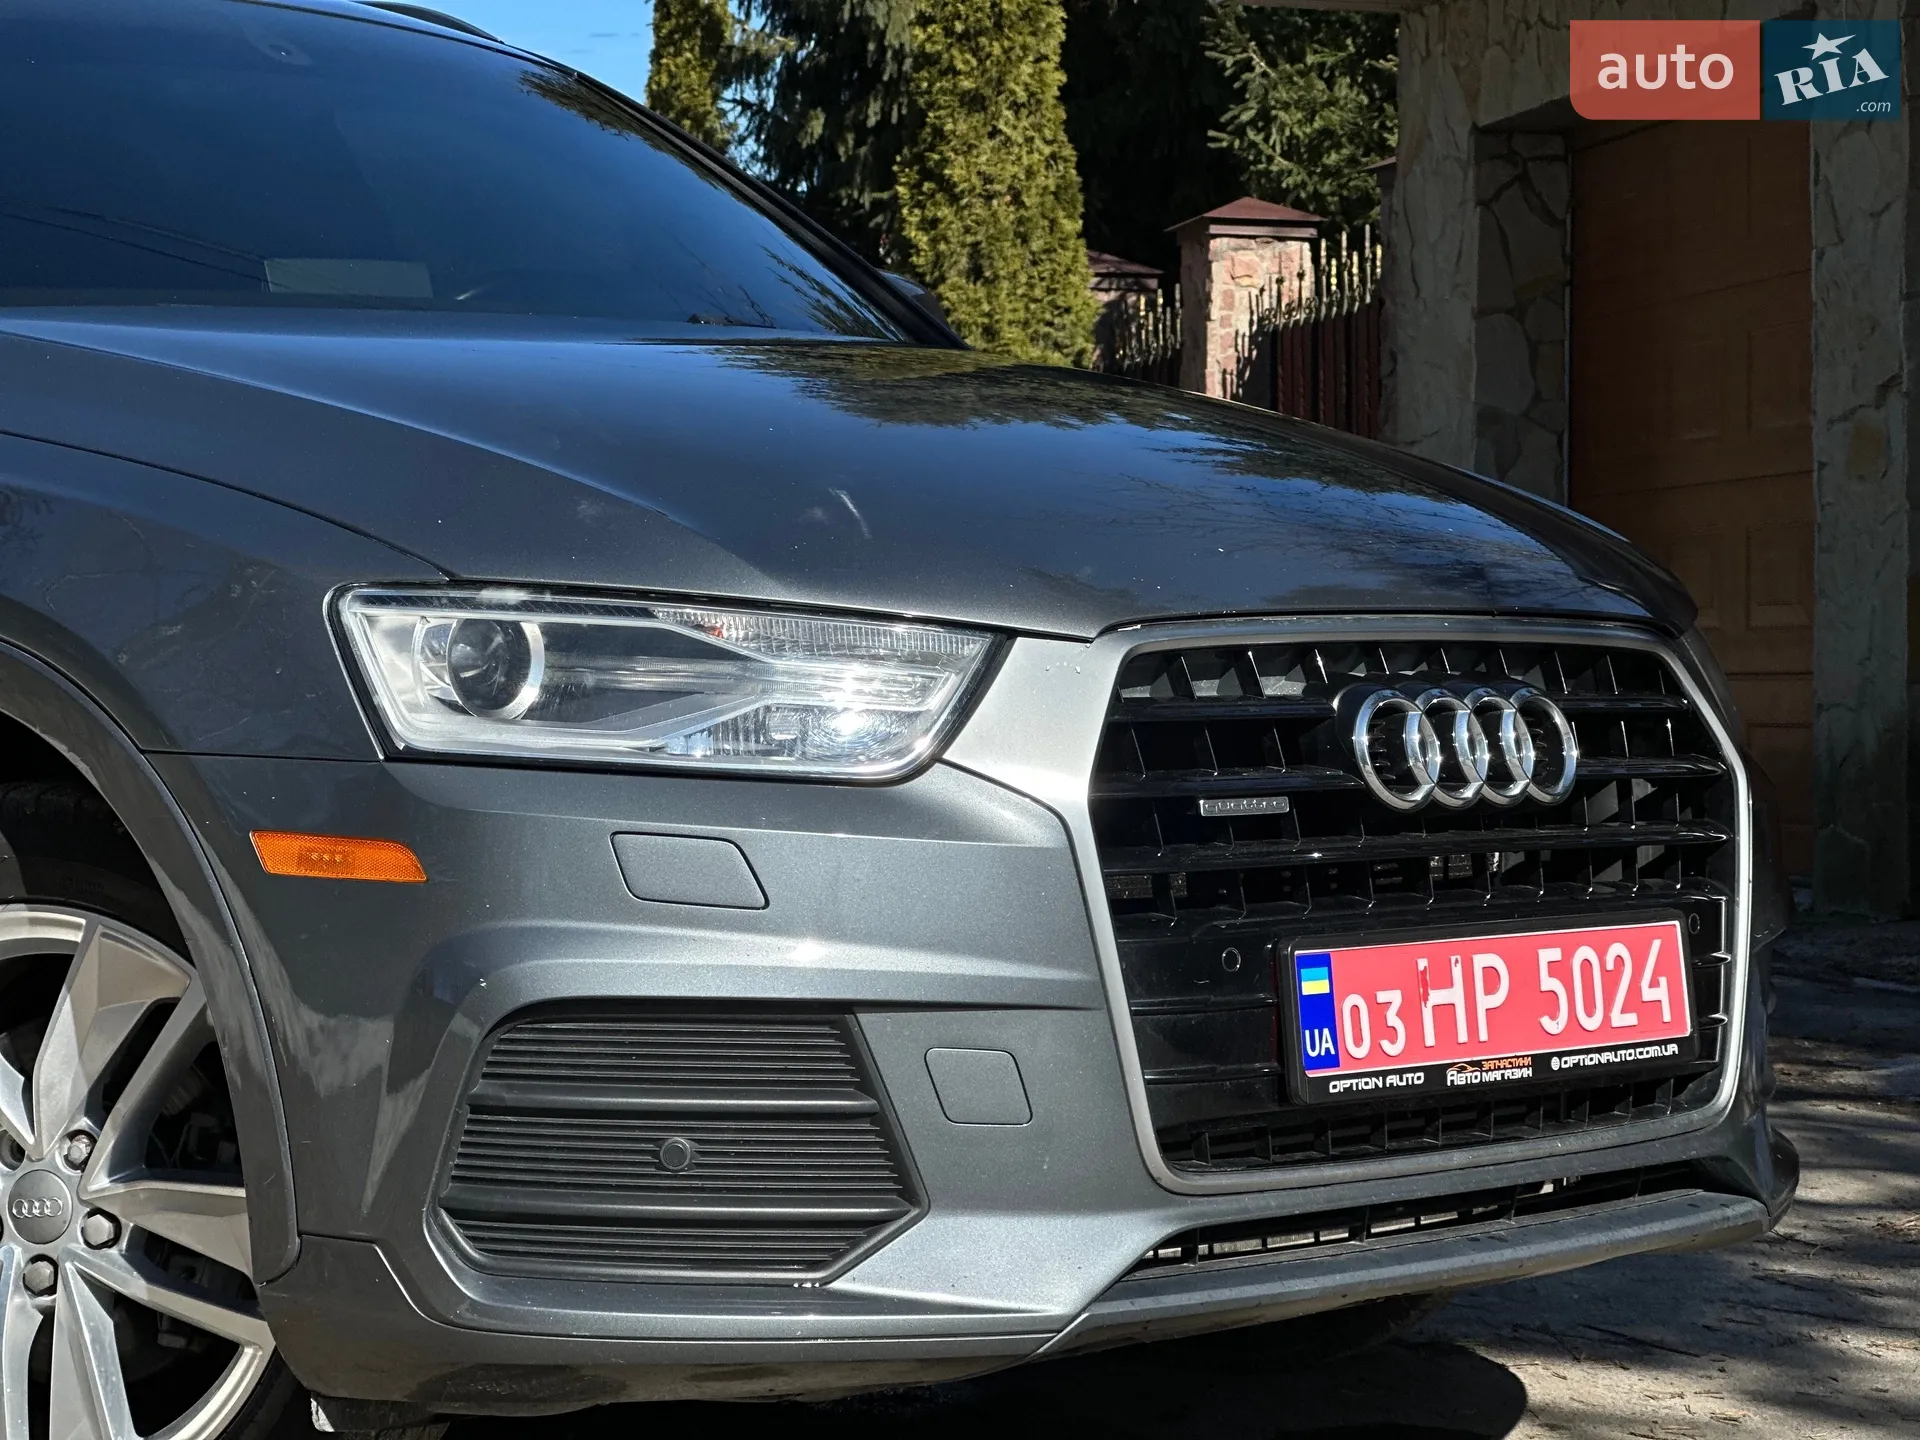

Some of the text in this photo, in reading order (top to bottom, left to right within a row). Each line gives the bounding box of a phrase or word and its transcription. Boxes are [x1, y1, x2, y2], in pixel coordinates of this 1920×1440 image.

[1342, 938, 1672, 1059] 03 HP 5024
[1305, 1028, 1335, 1057] UA
[1481, 1056, 1532, 1071] ЗАПЧАСТИНИ
[1386, 1071, 1425, 1088] AUTO
[1482, 1067, 1532, 1082] МАГАЗИН
